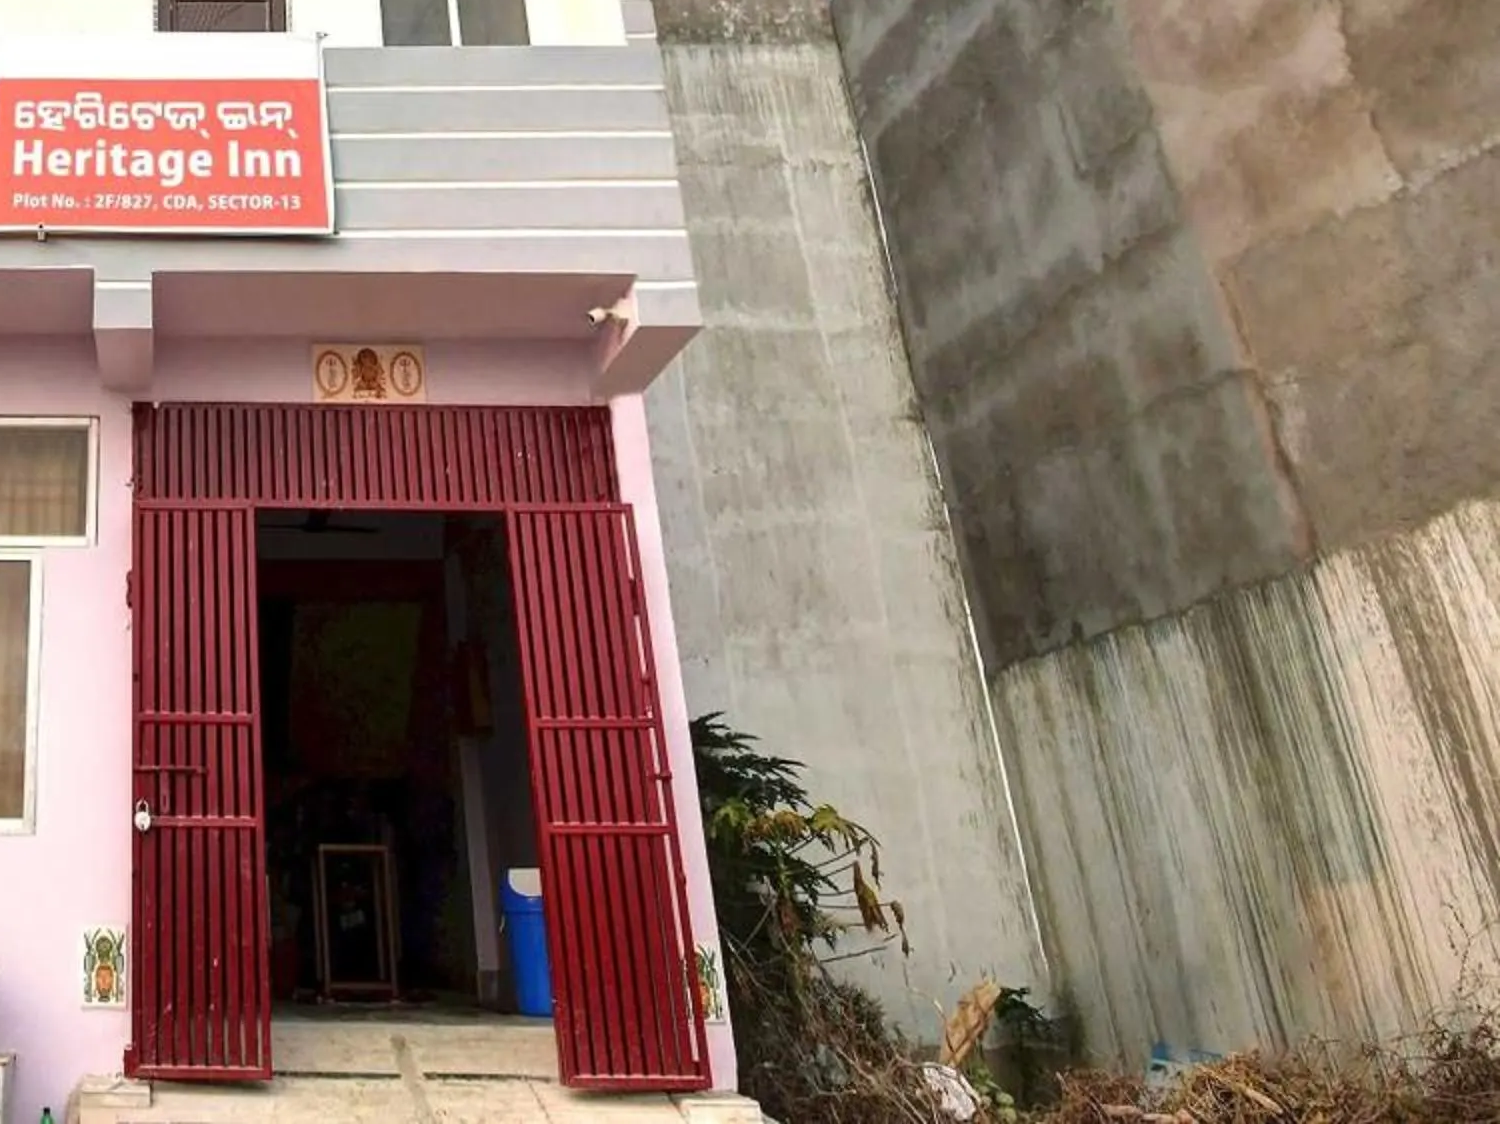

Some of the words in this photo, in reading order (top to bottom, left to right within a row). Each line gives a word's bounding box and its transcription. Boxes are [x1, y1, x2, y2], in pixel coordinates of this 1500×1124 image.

[13, 138, 213, 188] Heritage
[228, 140, 301, 177] Inn
[13, 193, 47, 208] Plot
[51, 193, 79, 209] No.
[94, 193, 157, 211] 2F/827,
[163, 194, 203, 211] CDA,
[208, 195, 301, 210] SECTOR-13
